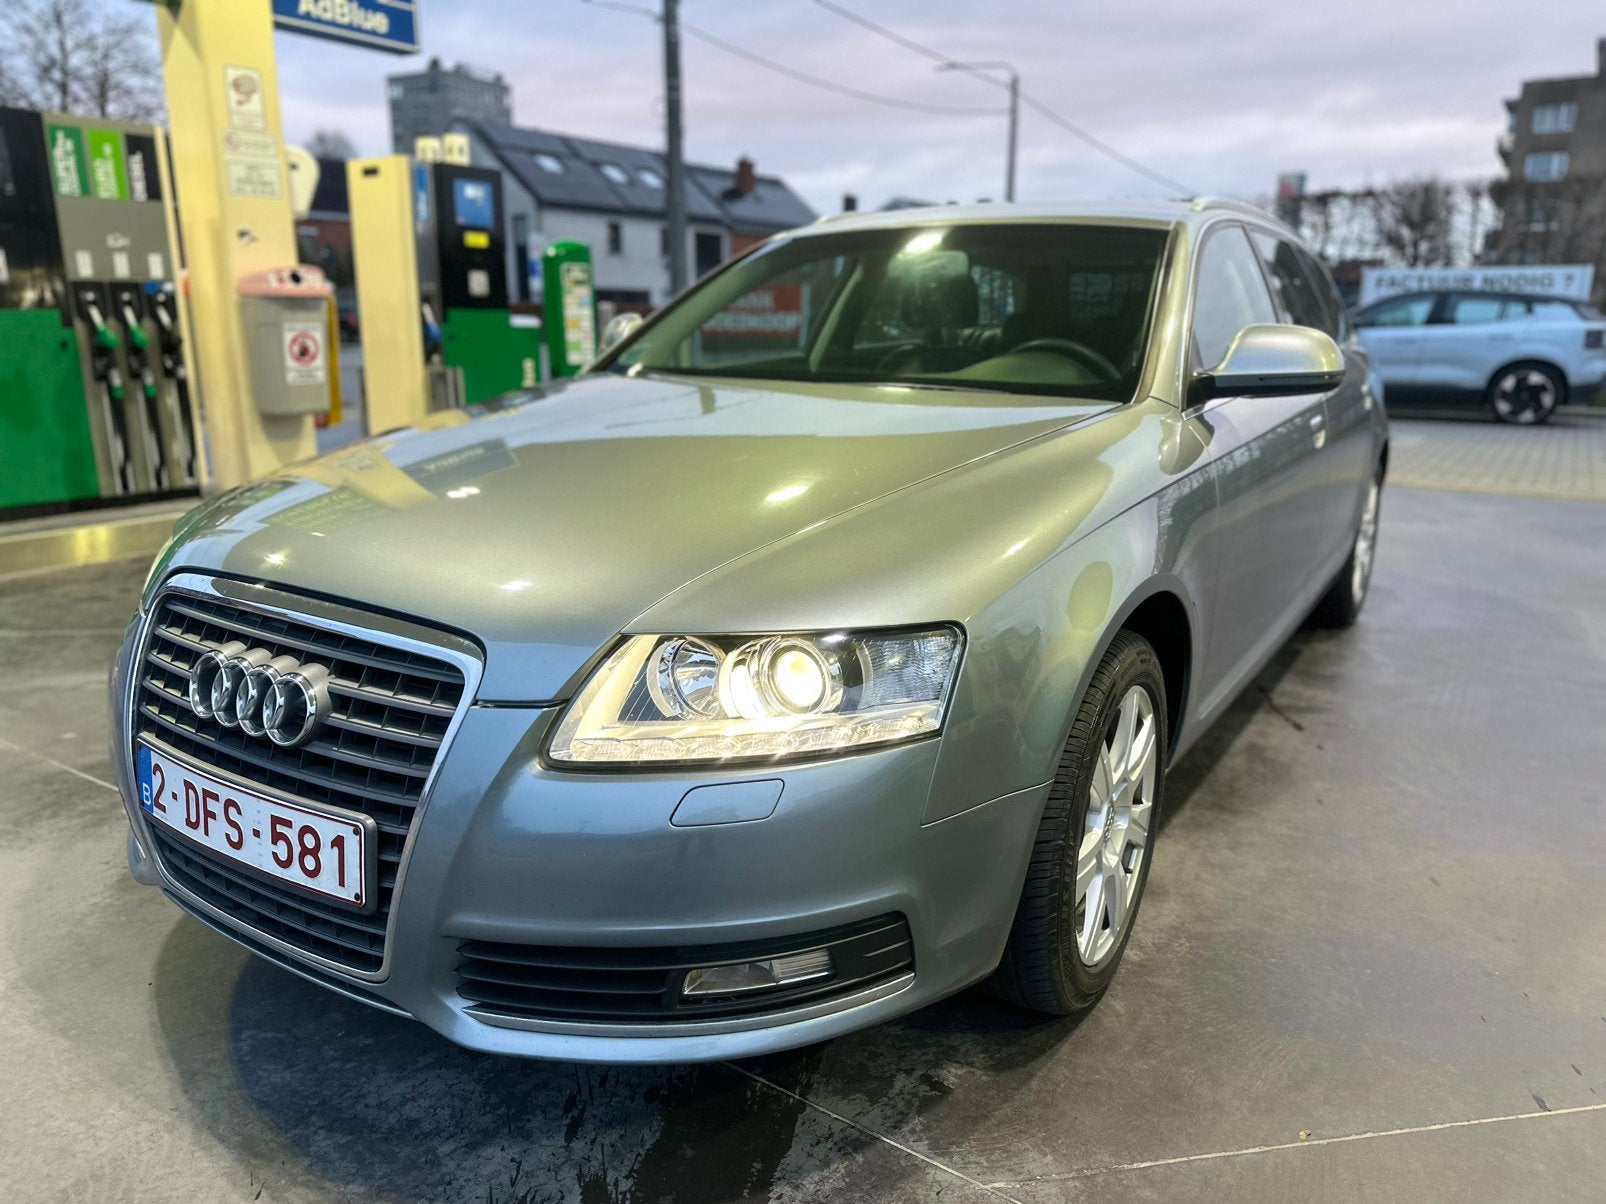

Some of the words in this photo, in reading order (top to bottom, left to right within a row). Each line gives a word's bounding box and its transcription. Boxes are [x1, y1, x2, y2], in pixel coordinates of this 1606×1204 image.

[297, 0, 389, 35] AdBlue
[1481, 271, 1555, 292] NODIG
[143, 782, 152, 806] B
[151, 762, 346, 889] 2-DFS-581
